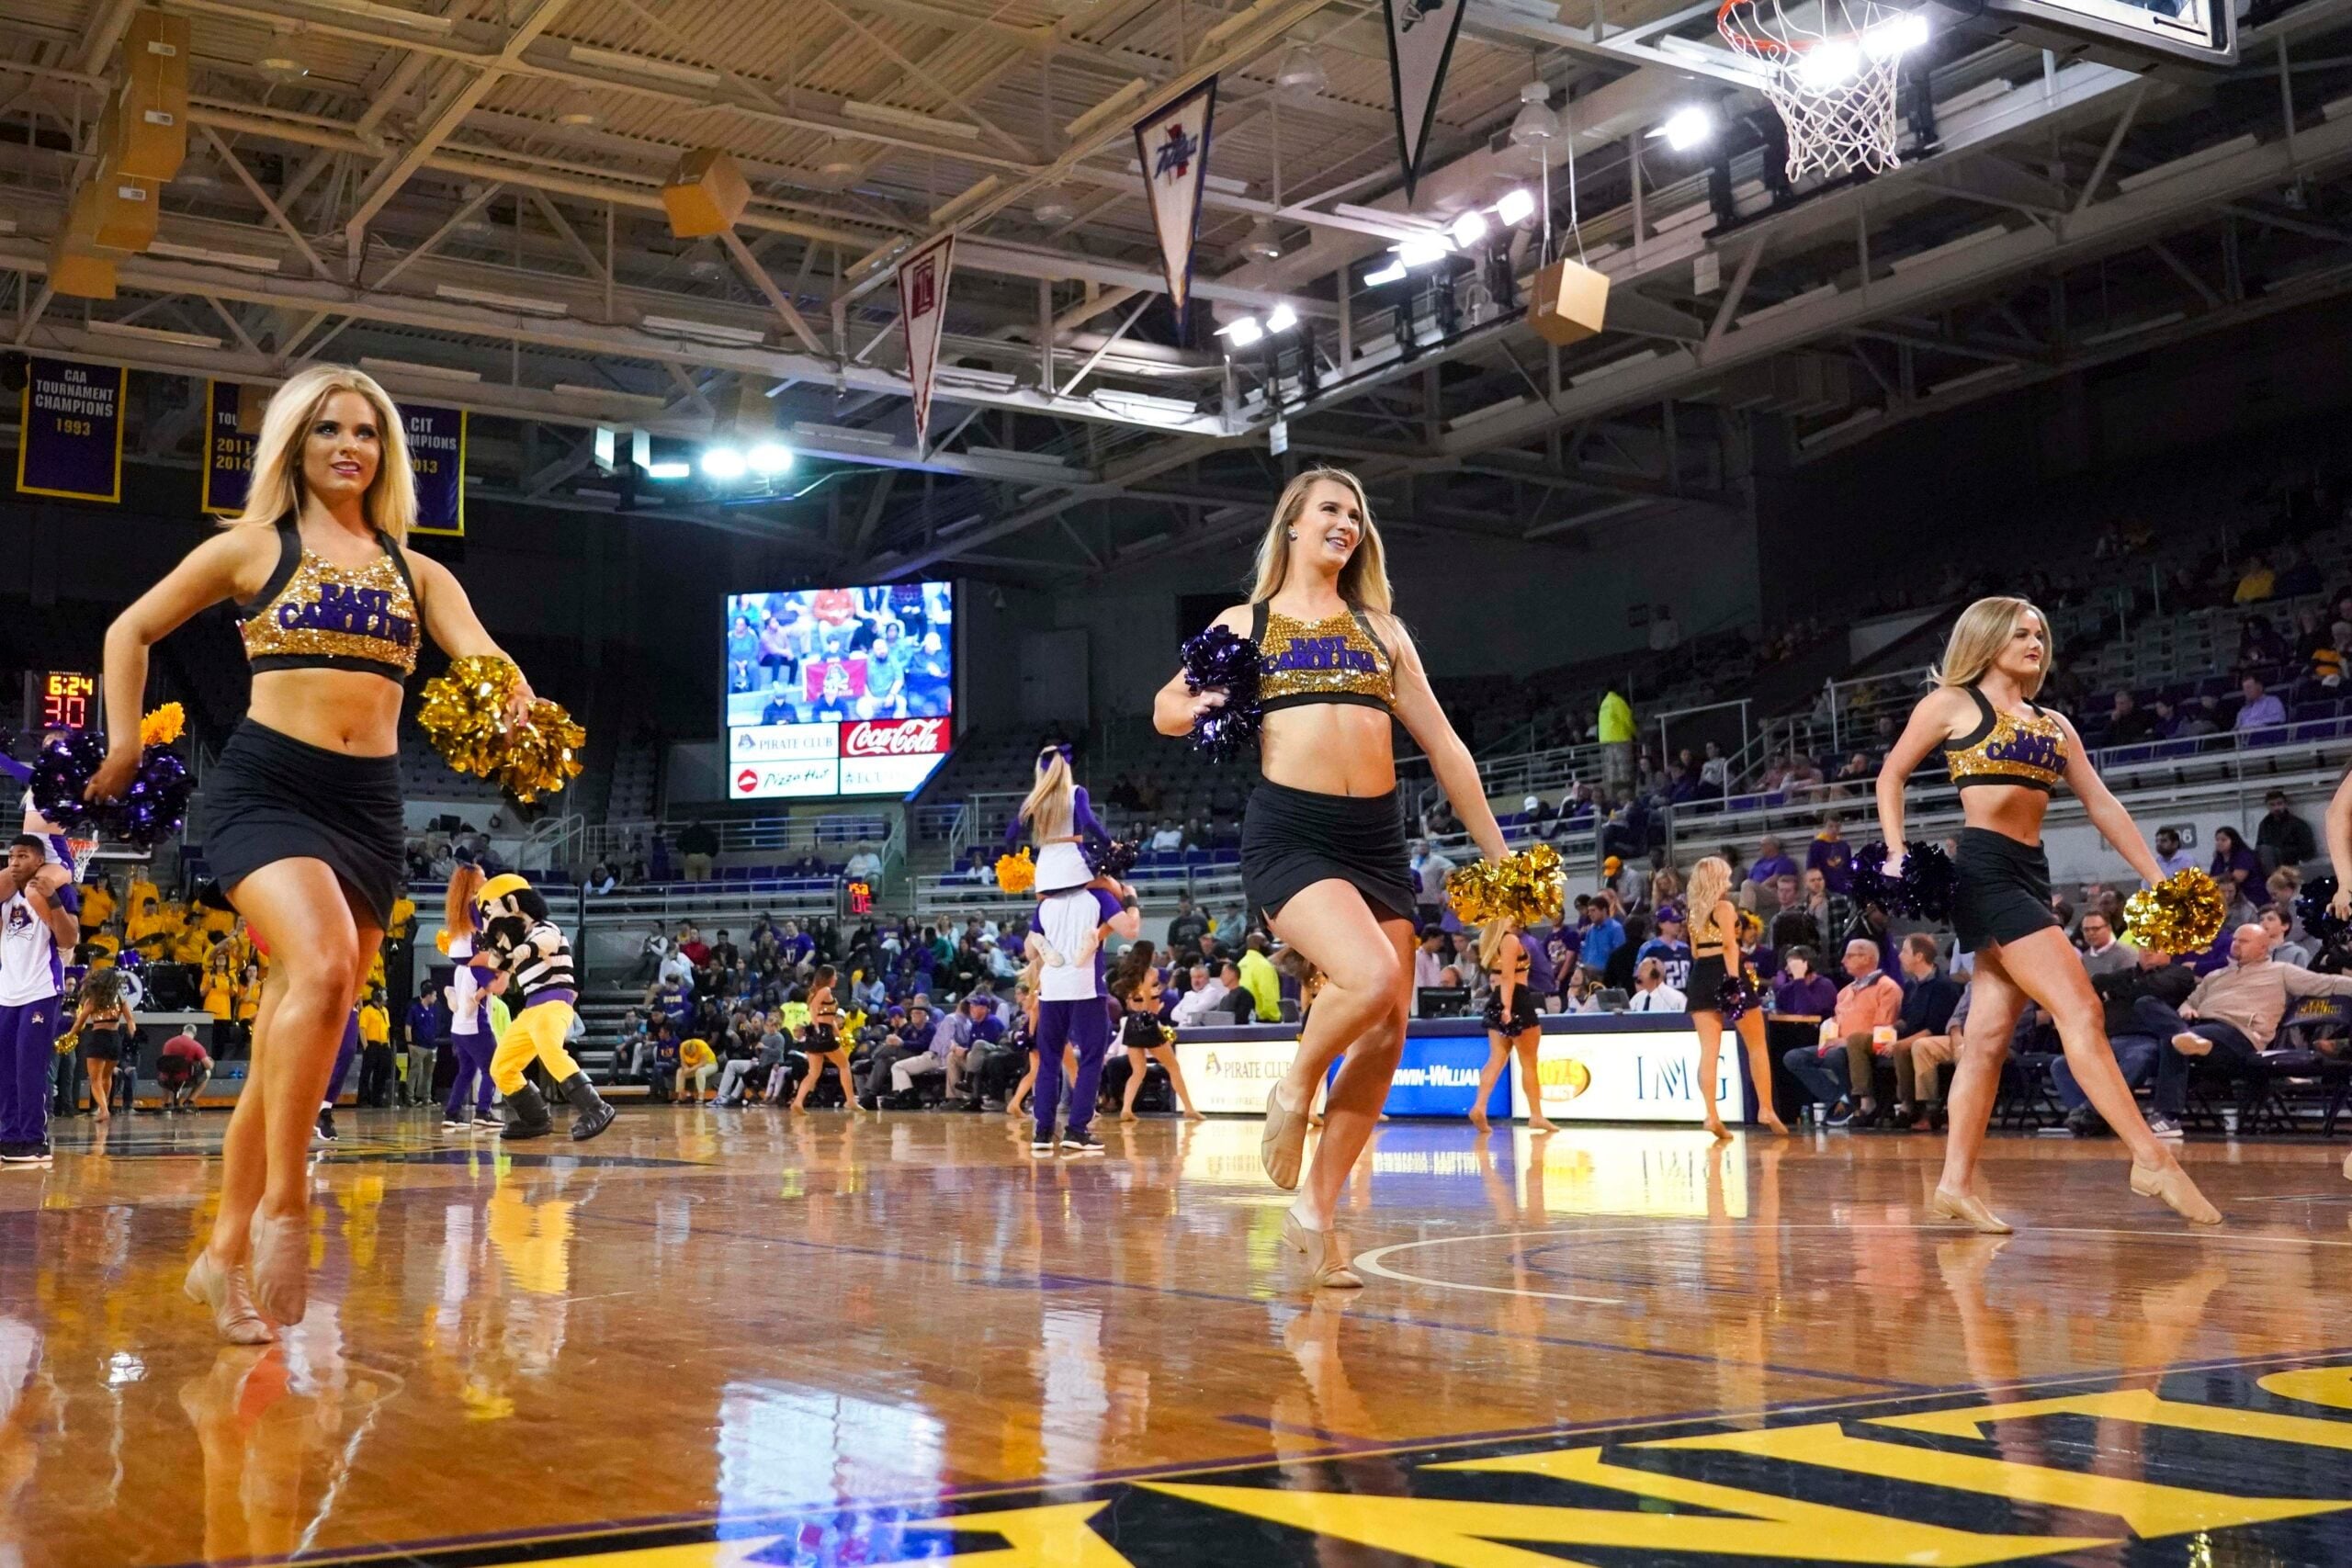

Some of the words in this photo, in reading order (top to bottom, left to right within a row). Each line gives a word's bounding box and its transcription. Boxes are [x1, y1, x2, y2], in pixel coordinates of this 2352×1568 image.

[64, 369, 87, 383] CAA
[36, 379, 114, 401] TOURNAMENT
[35, 394, 114, 418] CHAMPIONS
[56, 418, 91, 436] 1993
[411, 417, 434, 433] CIT
[1289, 636, 1347, 655] EAST
[1262, 649, 1379, 675] CAROLINA
[50, 676, 93, 696] 6:24
[44, 696, 85, 728] 30
[760, 739, 797, 750] PIRATE
[803, 737, 832, 748] CLUB
[846, 718, 944, 755] Coca-Cola
[1224, 1062, 1261, 1078] PIRATE
